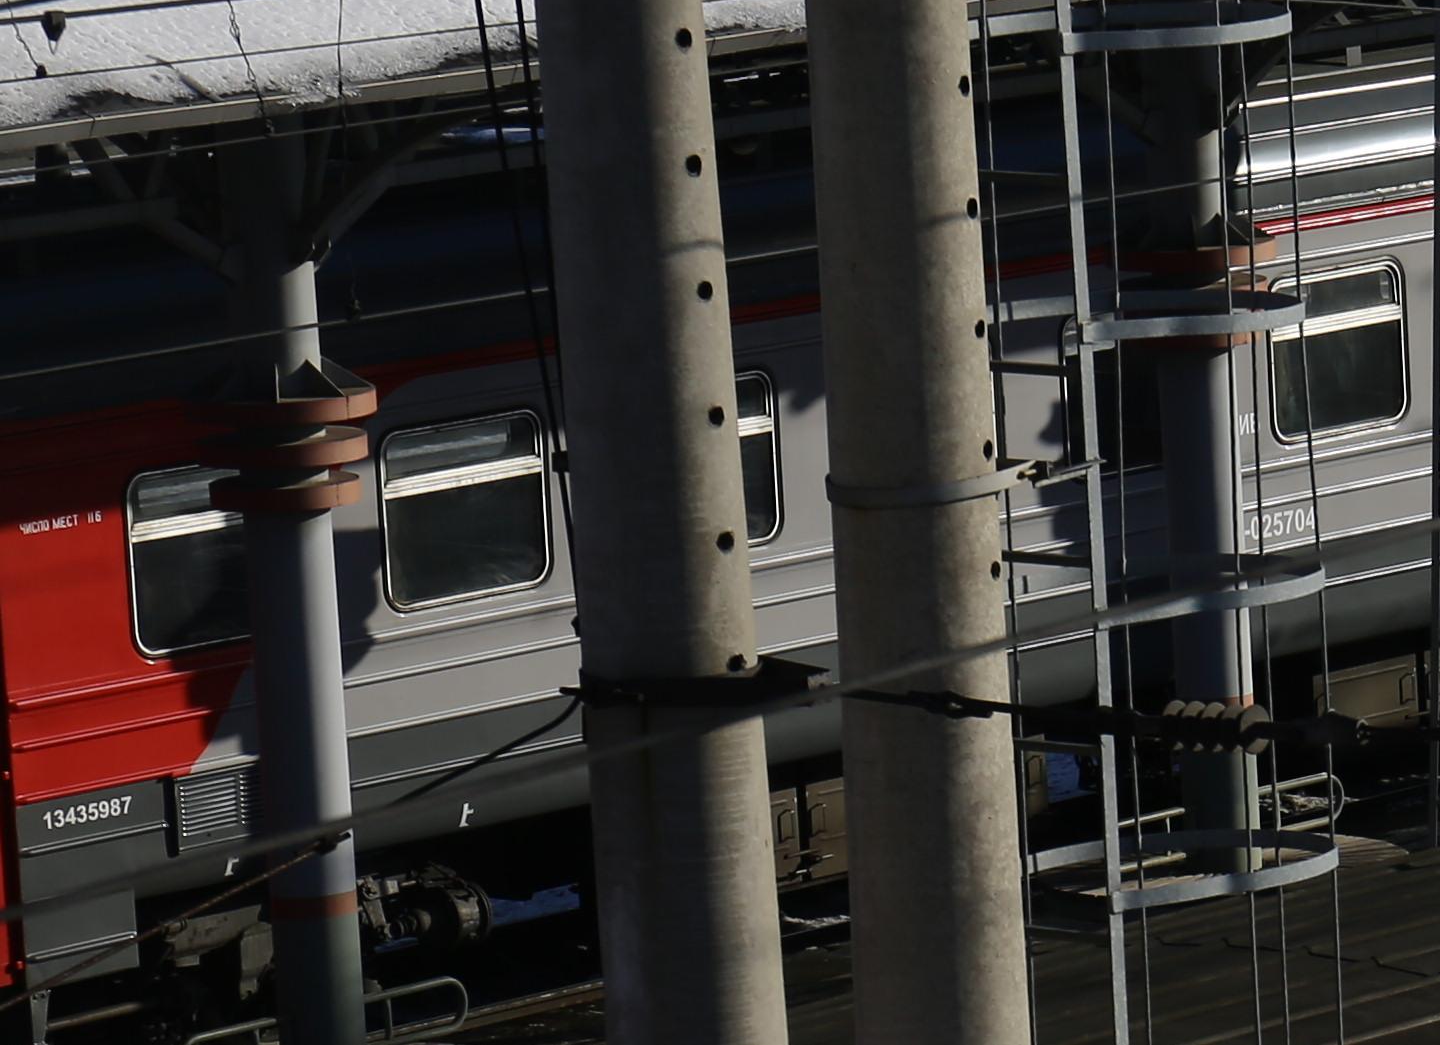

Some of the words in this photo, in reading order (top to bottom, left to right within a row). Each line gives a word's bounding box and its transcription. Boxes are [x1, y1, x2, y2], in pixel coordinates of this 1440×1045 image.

[52, 514, 79, 530] МЕСТ
[87, 510, 102, 524] 116
[42, 795, 132, 830] 13435987
